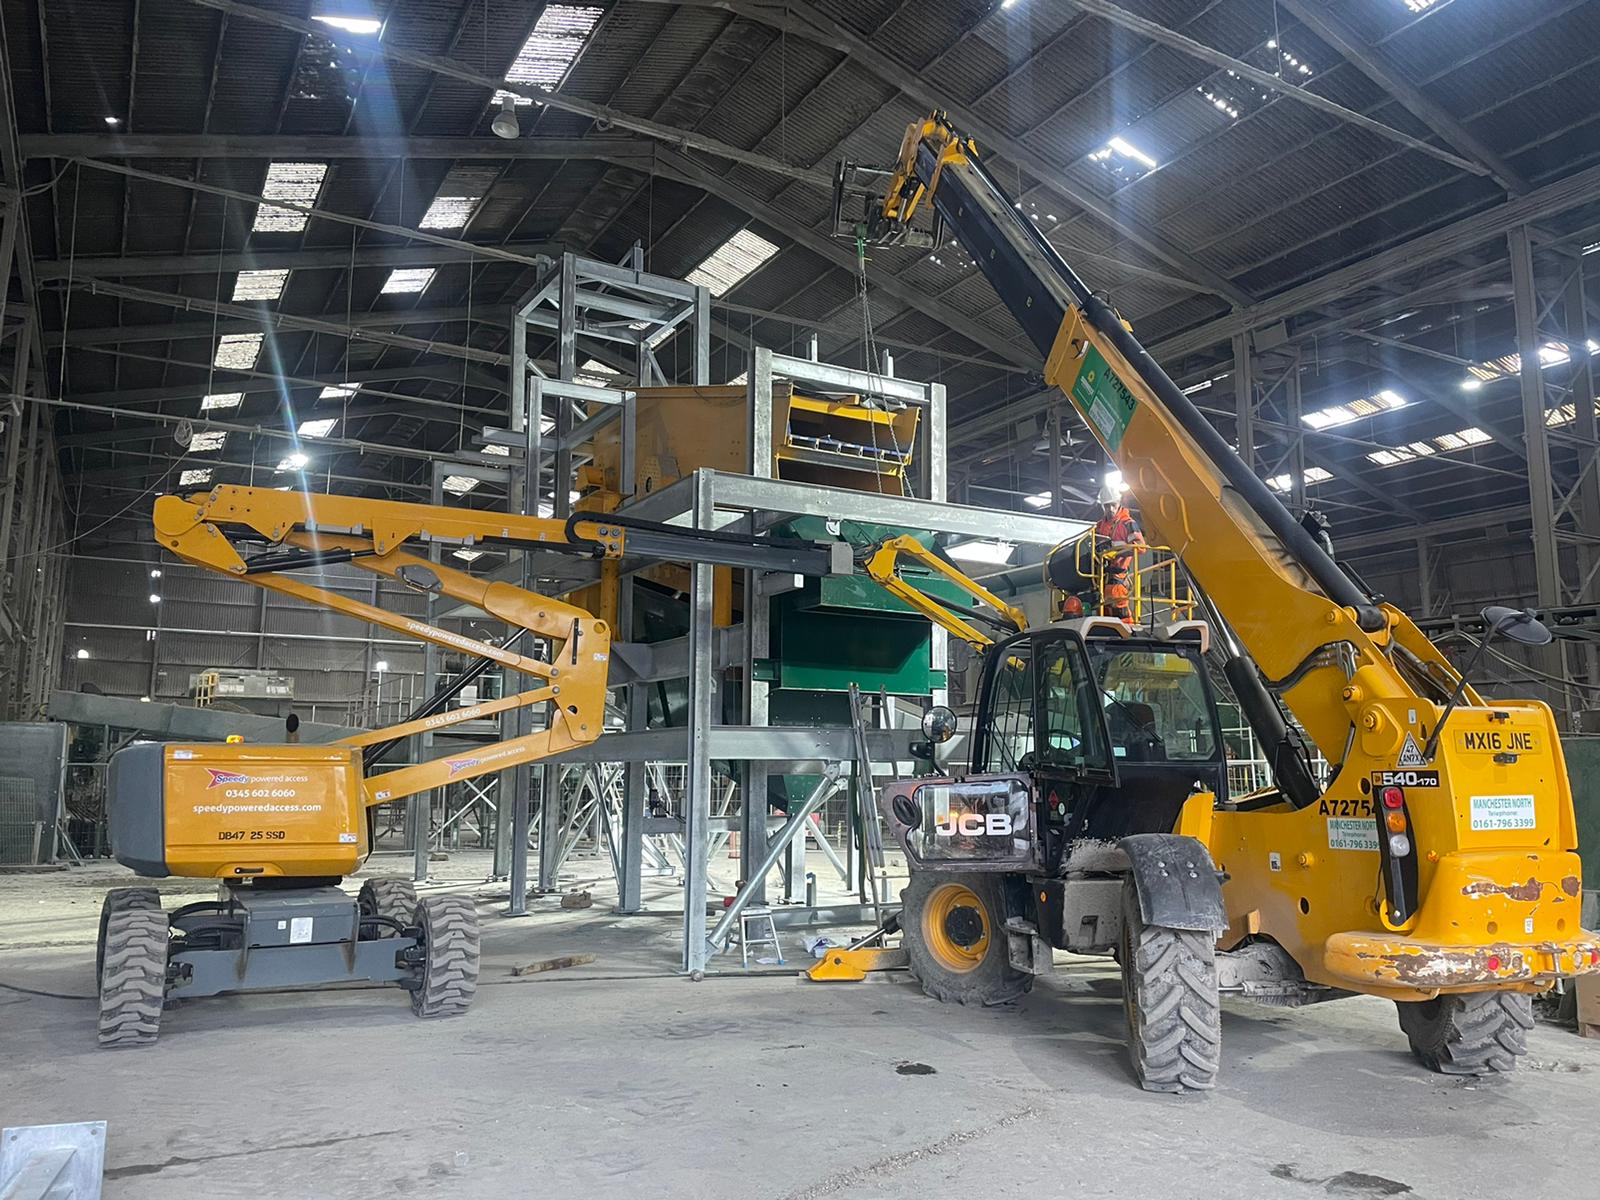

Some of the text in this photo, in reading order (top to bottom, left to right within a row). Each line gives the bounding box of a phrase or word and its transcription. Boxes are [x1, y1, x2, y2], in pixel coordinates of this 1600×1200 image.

[1103, 367, 1136, 410] A727543
[406, 621, 504, 658] speedypoweredaccess.com
[1464, 732, 1533, 749] MX16 JNE
[216, 774, 250, 783] Speedy
[250, 775, 284, 783] powered
[225, 789, 296, 798] 0345 602 6060
[192, 803, 322, 813] speedypoweredaccess.com
[1473, 798, 1532, 809] MANCHESTER NORTH
[936, 813, 1012, 836] JCB
[1329, 819, 1377, 831] MANCHESTER NORT
[1473, 818, 1534, 828] 0161-796 3399
[218, 831, 286, 840] DB47 25 SSD
[1330, 839, 1379, 849] 0161-796 339
